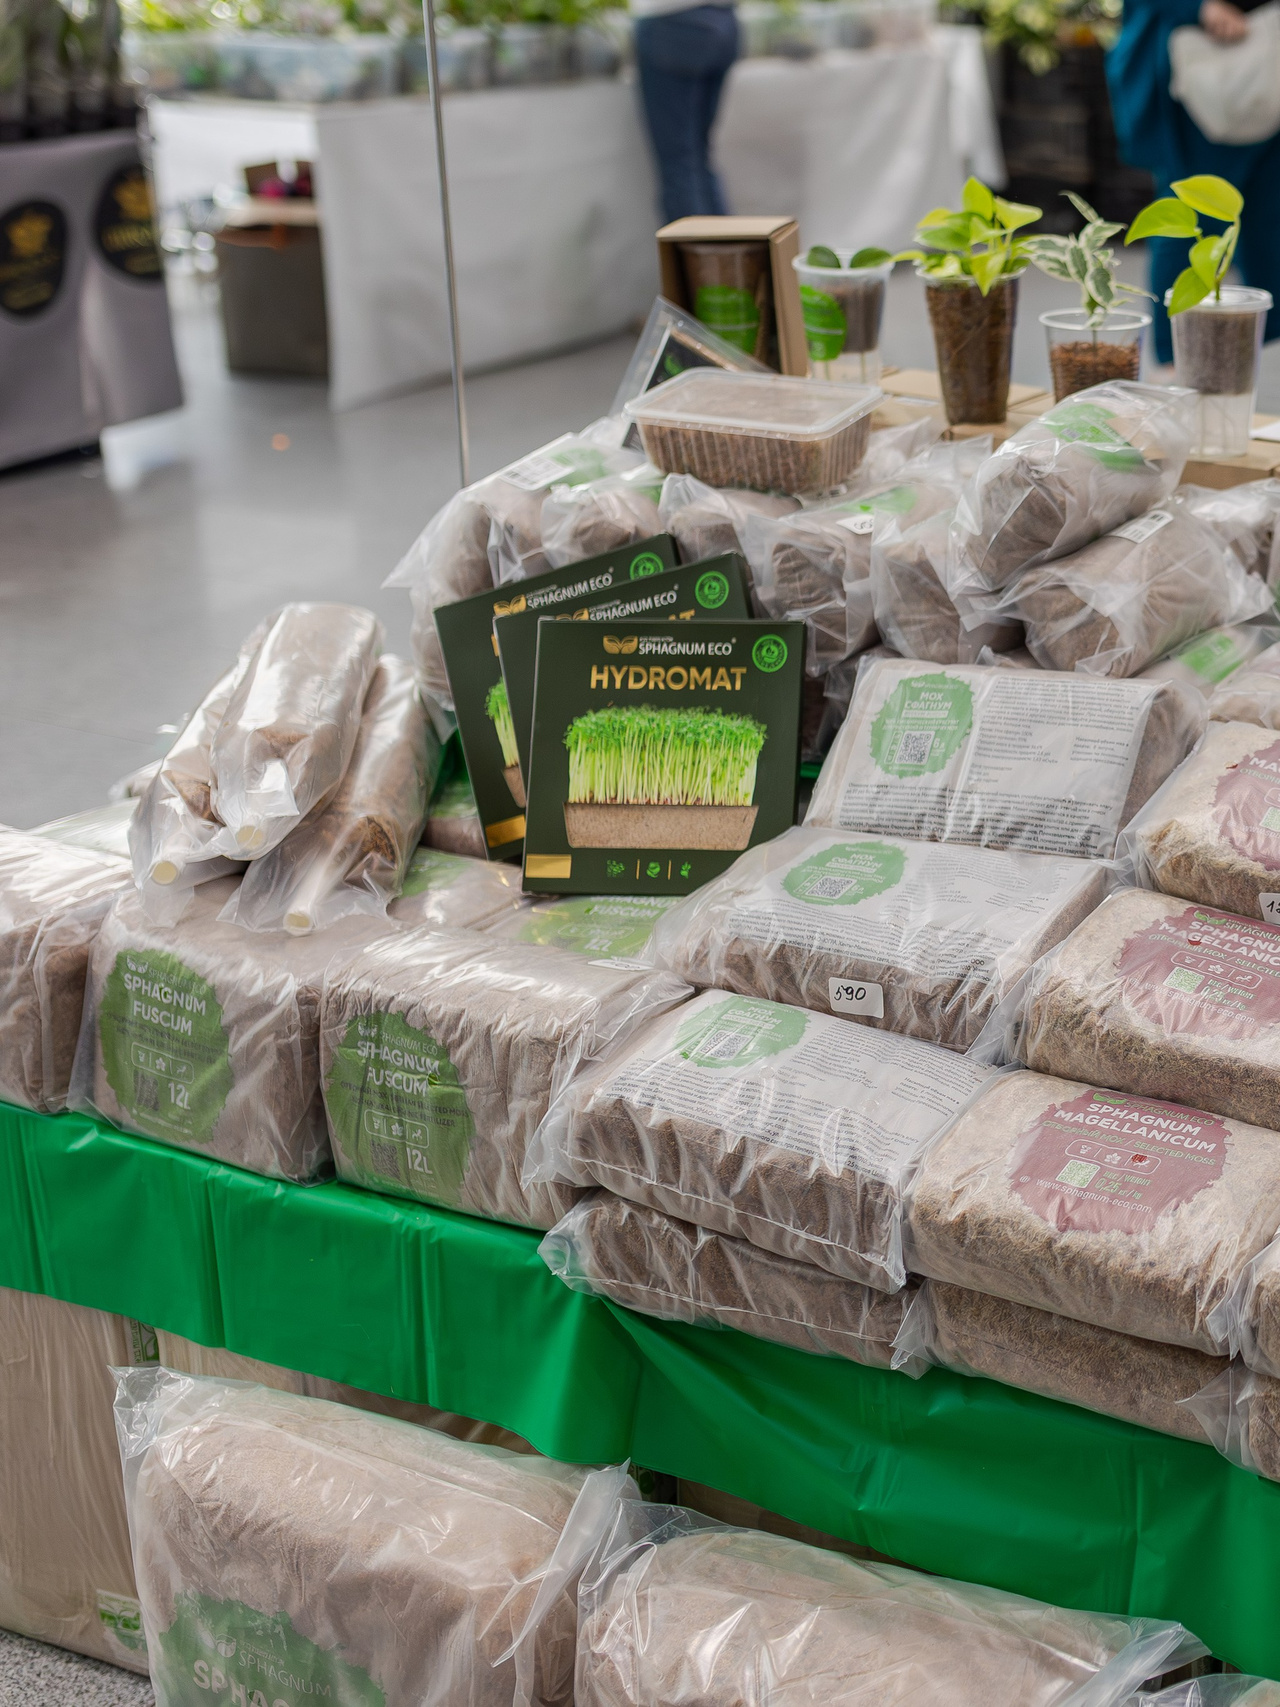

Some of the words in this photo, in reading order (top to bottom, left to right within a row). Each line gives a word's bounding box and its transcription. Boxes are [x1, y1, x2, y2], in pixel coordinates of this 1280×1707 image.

[527, 581, 589, 609] SPHAGNUM
[590, 572, 612, 590] ECO
[589, 598, 652, 620] SPHAGNUM
[654, 591, 677, 608] ECO
[638, 642, 706, 656] SPHAGNUM
[708, 642, 732, 656] ECO
[590, 665, 746, 690] HYDROMAT
[905, 701, 952, 709] СФАГНУМ
[920, 692, 943, 700] МОХ
[832, 857, 883, 868] СФАГНУМ
[124, 973, 206, 1016] SPHAGNUM
[834, 985, 867, 1001] 590
[133, 1001, 192, 1036] FUSCUM
[748, 1006, 775, 1015] МОХ
[422, 1043, 438, 1056] ECO
[168, 1082, 191, 1110] 12L
[1086, 1103, 1202, 1136] SPHAGNUM
[1124, 1101, 1189, 1121] SPHAGNUM
[1190, 1116, 1215, 1127] ECO
[1054, 1109, 1217, 1153] MAGELLANICUM
[407, 1147, 433, 1175] 12L
[1036, 1178, 1152, 1214] www.sphagnum-eco.com
[193, 1659, 291, 1707] SPHA
[238, 1650, 332, 1698] SPHAGNUM
